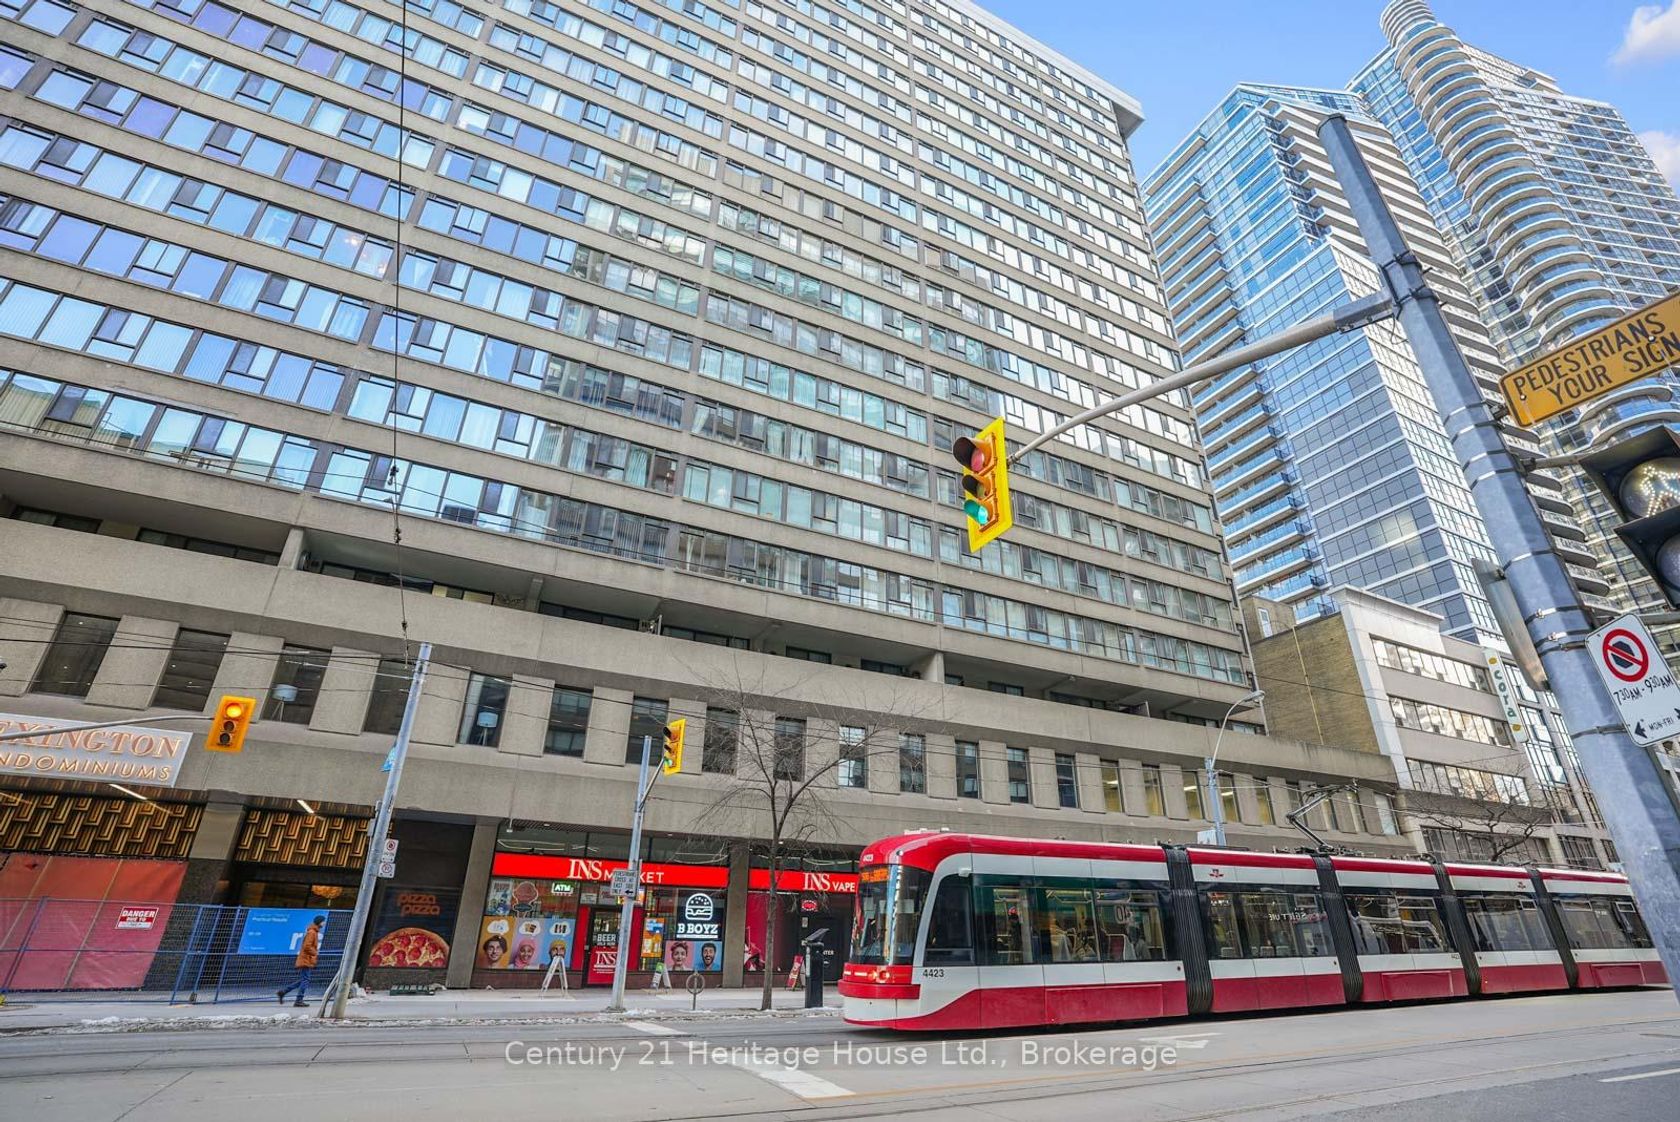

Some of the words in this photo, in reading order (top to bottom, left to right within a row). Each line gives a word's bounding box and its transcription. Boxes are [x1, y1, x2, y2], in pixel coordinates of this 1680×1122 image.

[1514, 312, 1666, 395] PEDESTRIANS
[1547, 365, 1612, 405] YOUR
[567, 859, 603, 880] INS
[603, 869, 665, 884] MKET
[554, 884, 572, 892] ATM
[803, 872, 831, 892] INS
[832, 881, 856, 893] VAPE
[677, 923, 686, 934] B
[687, 923, 719, 935] BOYZ
[597, 933, 617, 942] BEER
[596, 951, 617, 966] INS
[923, 969, 945, 978] 4423
